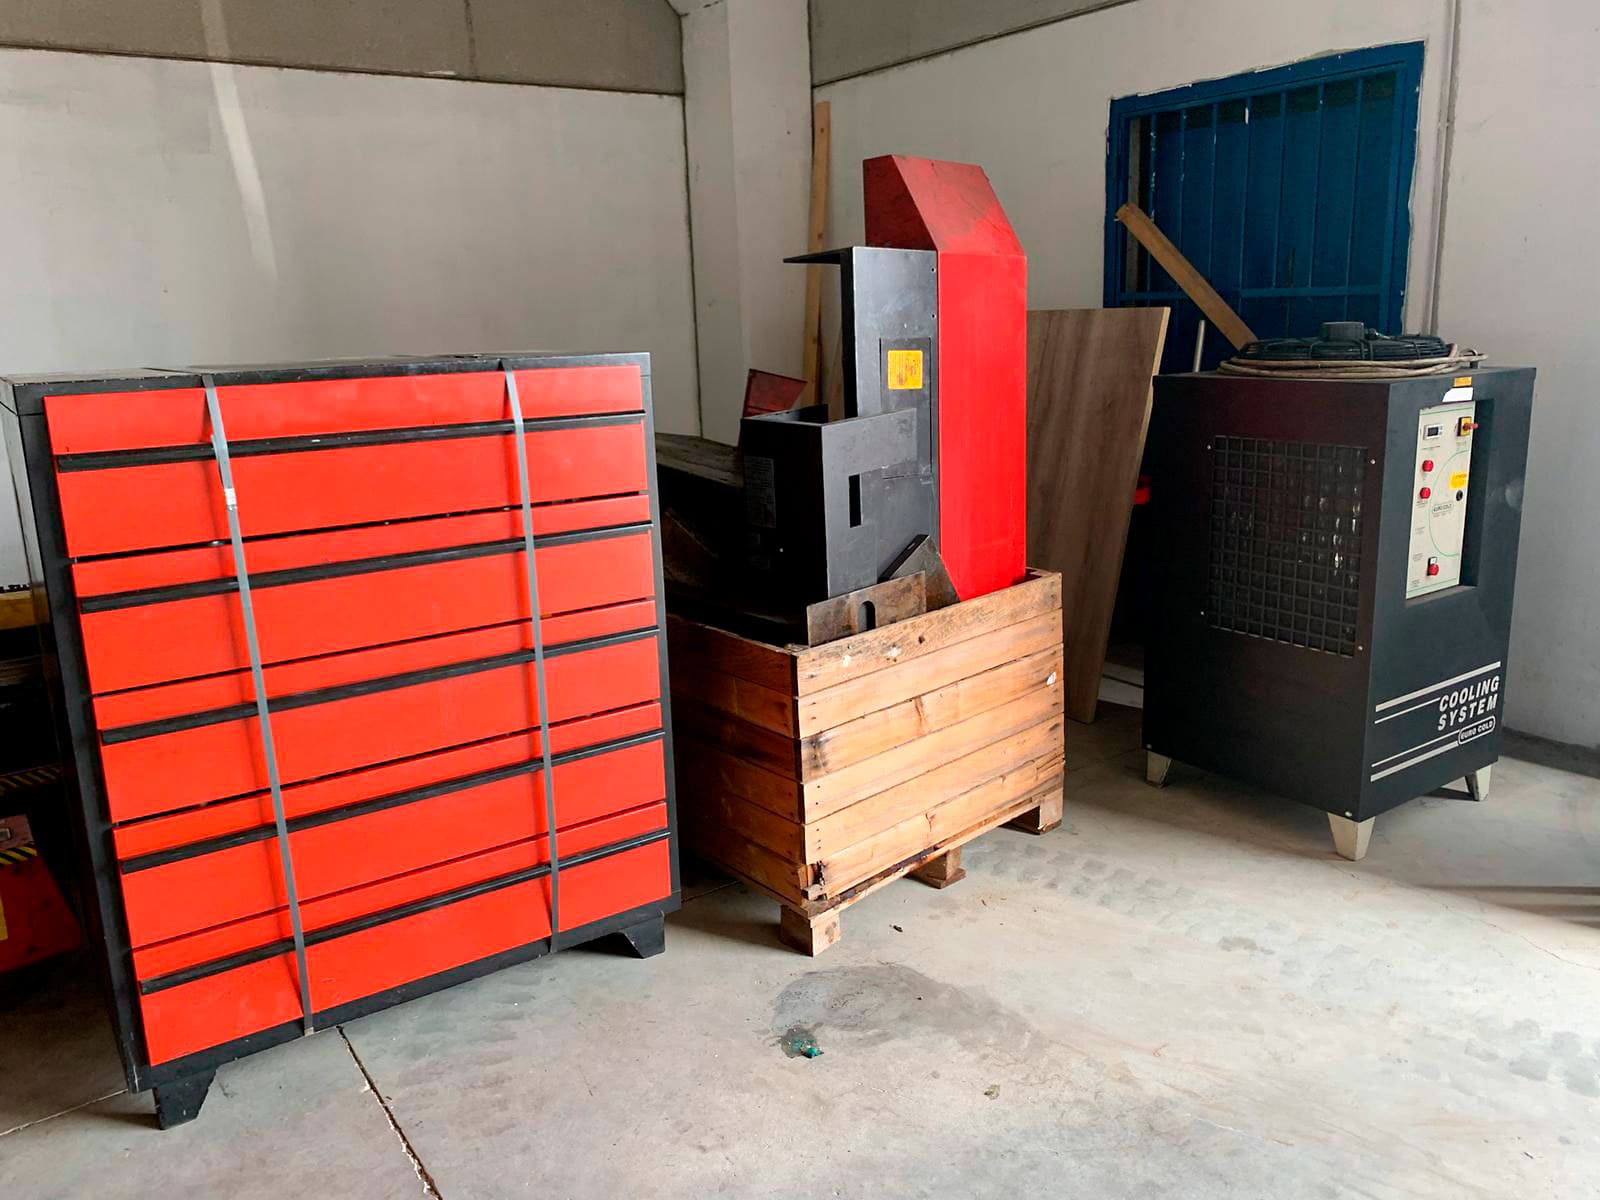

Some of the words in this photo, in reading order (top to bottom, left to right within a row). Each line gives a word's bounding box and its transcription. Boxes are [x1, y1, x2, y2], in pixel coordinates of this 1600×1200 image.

[1439, 675, 1500, 712] COOLING
[1437, 694, 1498, 731] SYSTEM
[1477, 720, 1493, 733] COLD
